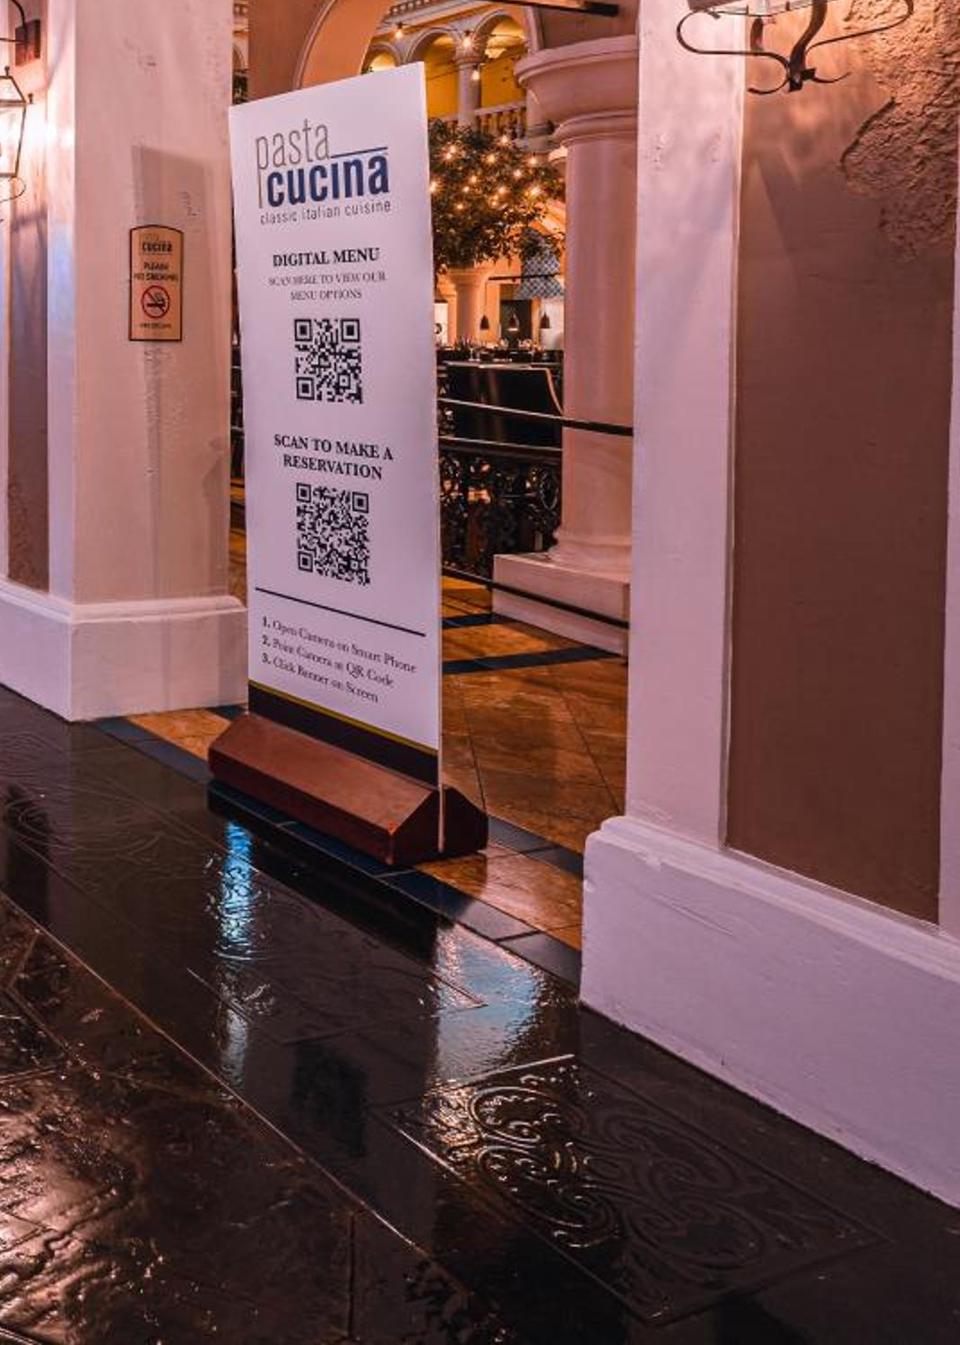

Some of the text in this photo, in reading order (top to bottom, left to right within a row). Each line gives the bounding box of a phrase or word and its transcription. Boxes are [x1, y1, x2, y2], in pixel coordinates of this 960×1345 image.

[256, 118, 330, 208] pasta
[267, 155, 389, 207] cucina
[260, 199, 391, 225] classic italian cuisine
[272, 247, 380, 267] DIGITAL MENU
[268, 271, 385, 286] SCAN HERE TO VIEW OUR
[290, 288, 362, 300] MENU OPTIONS
[274, 433, 393, 460] SCAN TO MAKE A
[283, 454, 382, 480] RESERVATION
[262, 615, 417, 674] 1. Open Camera on Smart Phone
[262, 634, 271, 647] 2.
[296, 646, 332, 667] Camera
[346, 662, 365, 679] QR
[366, 668, 394, 687] Code
[262, 652, 271, 665] 3.
[272, 658, 296, 673] Click
[346, 681, 379, 703] Screen
